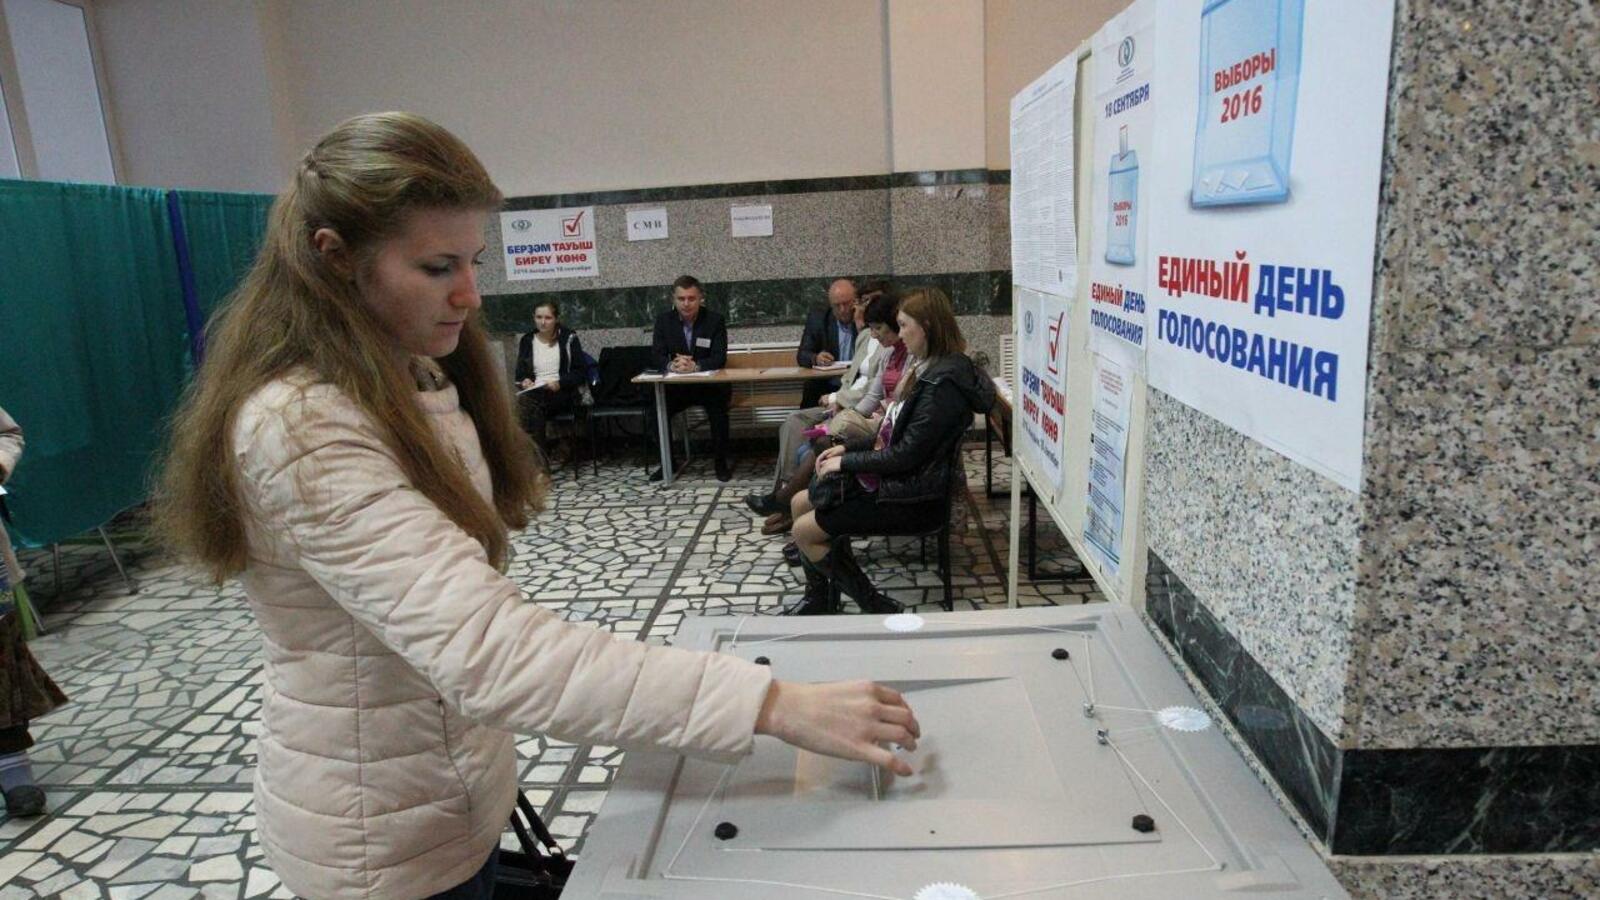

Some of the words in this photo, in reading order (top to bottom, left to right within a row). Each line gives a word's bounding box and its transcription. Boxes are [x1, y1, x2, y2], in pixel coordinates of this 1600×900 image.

[1214, 48, 1276, 92] ВЫБОРЫ
[1113, 83, 1150, 115] СЕНТЯБРЯ
[1220, 86, 1263, 123] 2016
[552, 241, 593, 252] ТАУЫШ
[556, 253, 587, 264] КӨНӨ
[1091, 282, 1123, 307] ЕДИНЫЙ
[1123, 290, 1146, 314] ДЕНЬ
[1158, 250, 1250, 303] ЕДИНЫЙ
[1254, 264, 1345, 320] ДЕНЬ
[1090, 308, 1144, 346] ГОЛОСОВАНИЯ
[1158, 309, 1339, 402] ГОЛОСОВАНИЯ
